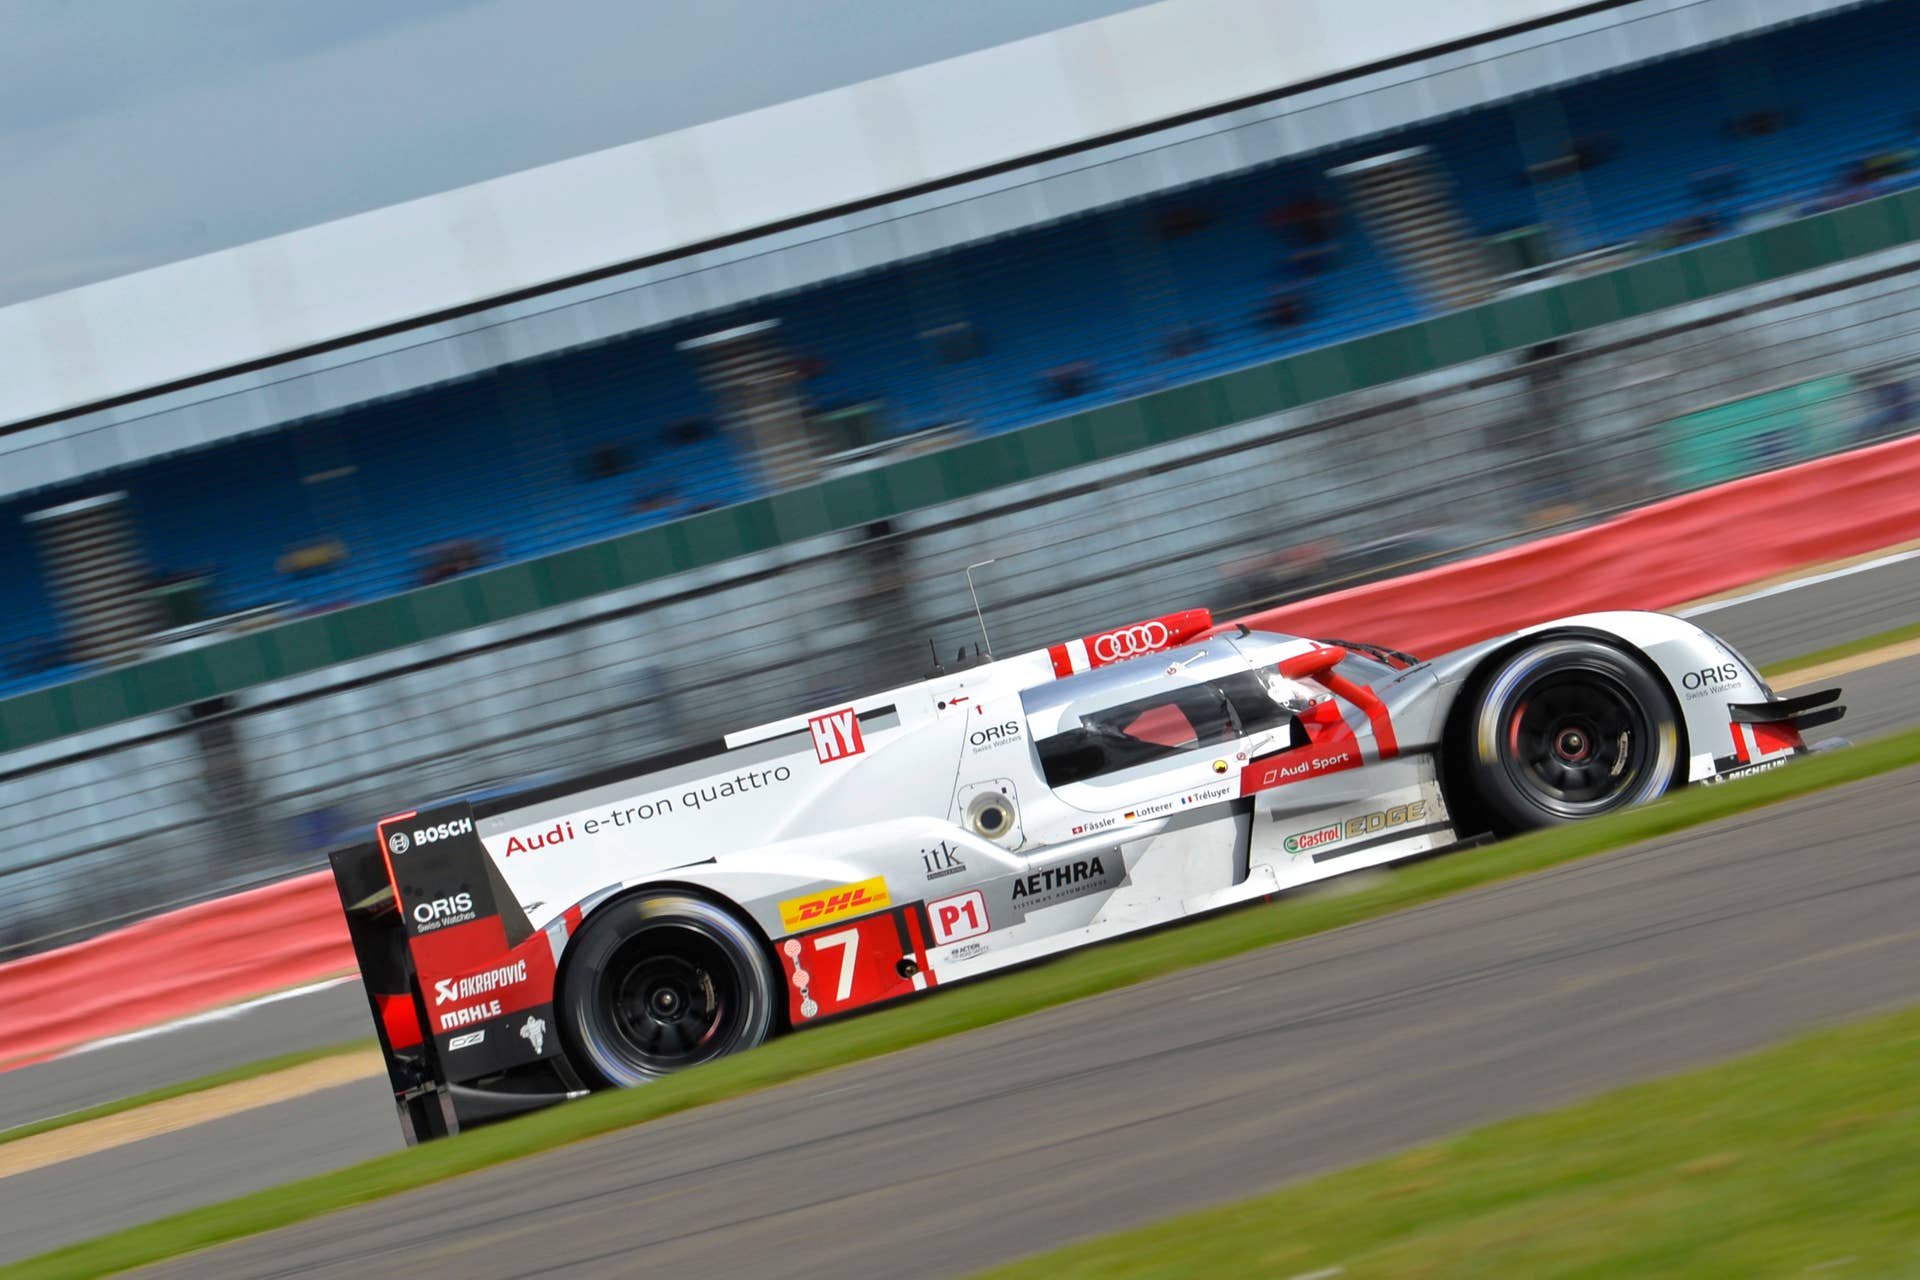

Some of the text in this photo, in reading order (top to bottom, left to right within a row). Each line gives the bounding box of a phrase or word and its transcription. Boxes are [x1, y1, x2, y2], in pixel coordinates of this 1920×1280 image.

[1682, 663, 1738, 690] ORIS
[1685, 681, 1742, 702] Swiss Watches
[810, 711, 857, 761] HY
[970, 721, 1019, 746] ORIS
[1280, 752, 1349, 778] Audi Sport
[1729, 759, 1785, 780] MICHELIN
[505, 766, 791, 857] Audi e-tron quattro
[1083, 786, 1231, 833] Fässler Lotterer Tréluyer
[1299, 800, 1427, 849] Castrol EDGE
[413, 817, 473, 846] BOSCH
[921, 840, 963, 873] itk
[1012, 856, 1105, 900] AETHRA
[414, 892, 473, 923] ORIS
[799, 888, 873, 921] DHL
[938, 900, 979, 937] P1
[417, 911, 476, 933] Swiss Watches
[814, 928, 860, 1002] 7
[440, 999, 502, 1030] MAHLE
